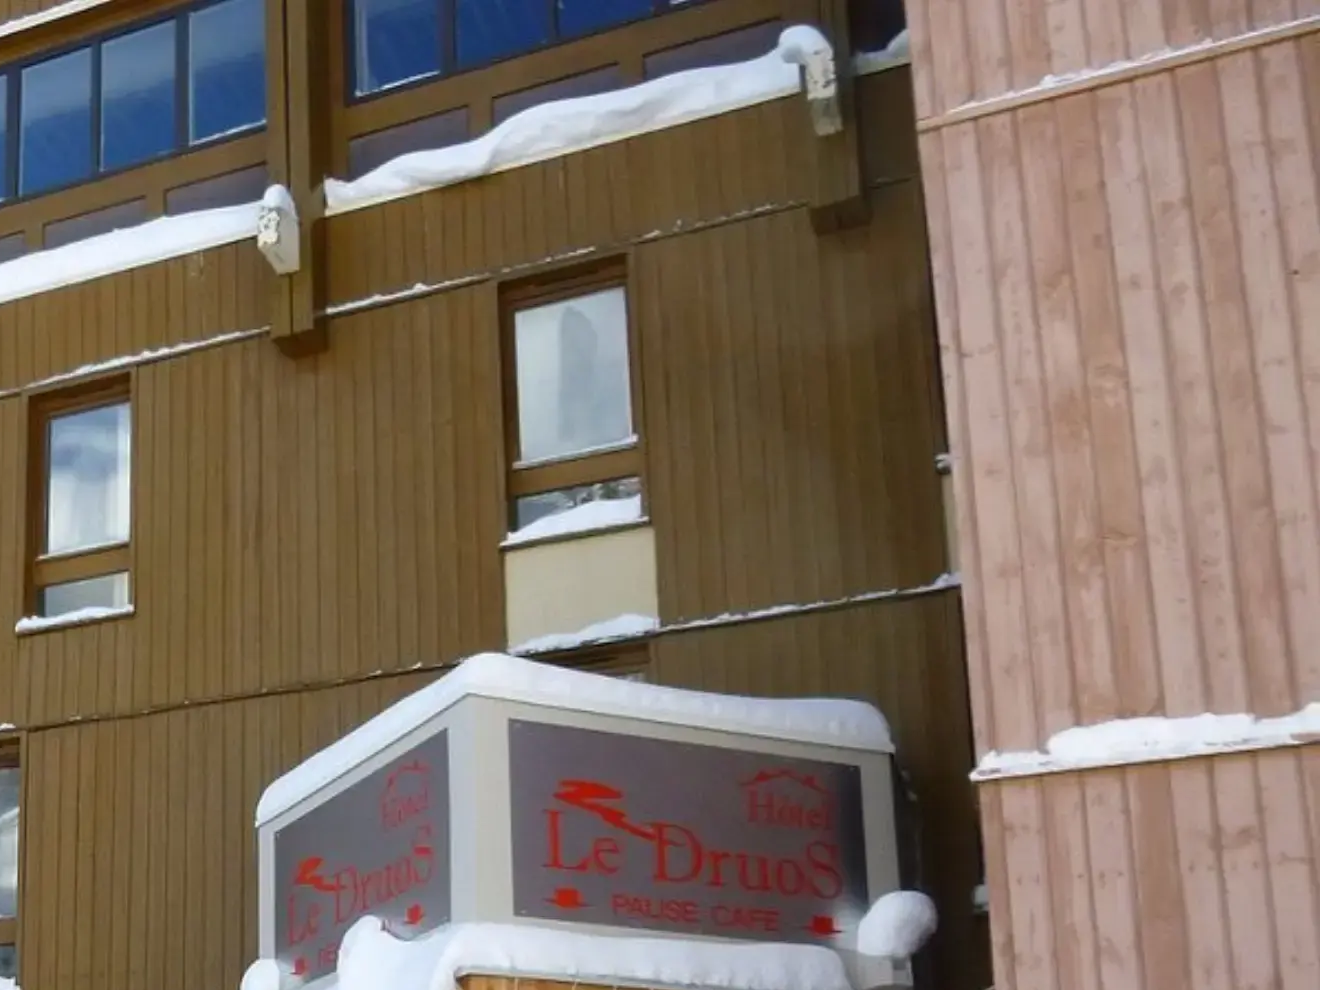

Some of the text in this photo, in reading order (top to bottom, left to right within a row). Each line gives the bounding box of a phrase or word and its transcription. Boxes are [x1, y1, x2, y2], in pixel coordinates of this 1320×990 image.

[542, 808, 620, 873] Le
[286, 892, 322, 946] Le
[610, 893, 699, 923] PAUSE
